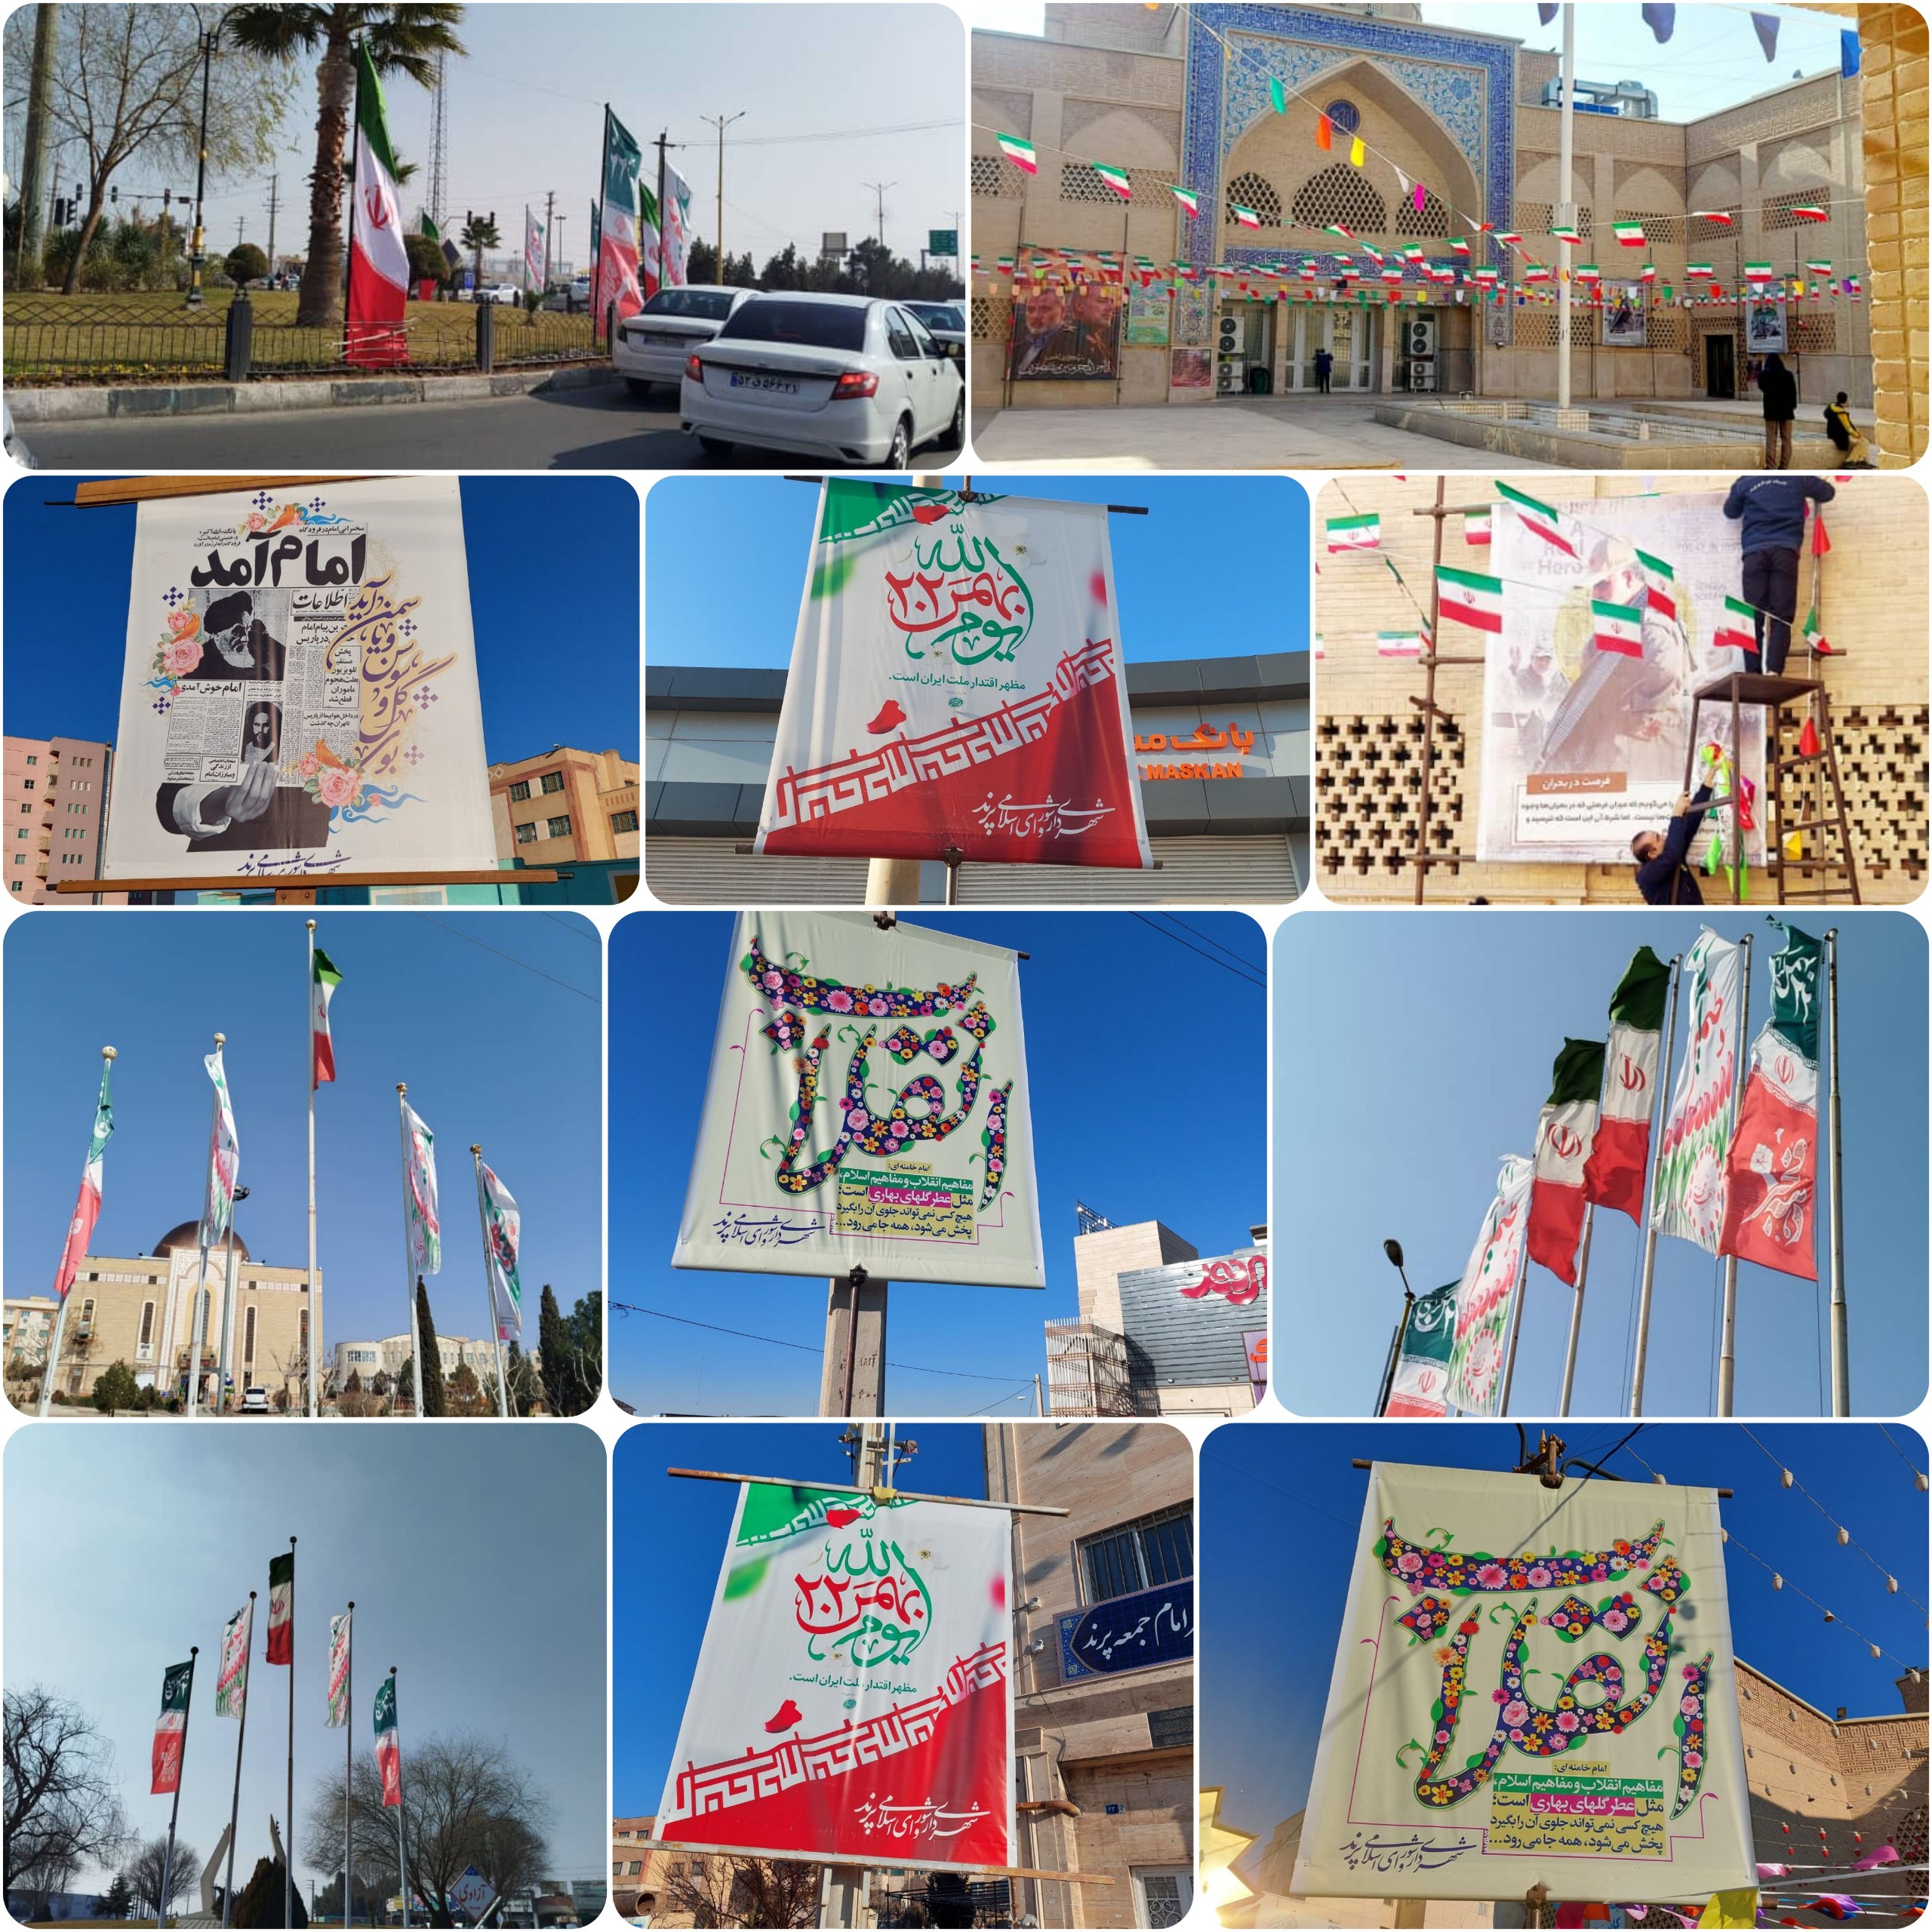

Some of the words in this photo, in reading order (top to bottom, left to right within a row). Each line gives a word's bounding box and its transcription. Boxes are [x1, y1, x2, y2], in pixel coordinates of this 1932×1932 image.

[191, 530, 281, 587] آمد
[271, 534, 366, 586] امام
[293, 589, 347, 610] اطلاعات
[302, 623, 315, 634] امام
[315, 623, 328, 634] پیام
[180, 682, 200, 692] آمدی
[921, 673, 944, 687] ایران
[947, 675, 969, 686] ملت
[970, 677, 998, 688] اقتدار
[998, 680, 1026, 691] مظهر
[199, 683, 222, 694] خوش
[222, 681, 242, 697] امام
[338, 696, 352, 705] قطع
[1171, 722, 1254, 755] بانک
[1147, 762, 1244, 780] MASKAN
[1543, 780, 1568, 789] بحران
[1583, 778, 1611, 789] فرصت
[972, 792, 996, 835] پرند
[743, 935, 1014, 1212] انقلاب
[871, 1172, 903, 1186] مفاهیم
[904, 1177, 909, 1186] و
[910, 1176, 940, 1188] انقلاب
[942, 1177, 973, 1191] مفاهیم
[869, 1188, 899, 1202] بهاری
[900, 1190, 931, 1204] گلهای
[931, 1192, 951, 1207] عطر
[952, 1195, 973, 1208] مثل
[836, 1201, 857, 1214] بگیرد
[864, 1202, 876, 1214] آن
[875, 1206, 899, 1217] جلوی
[936, 1211, 955, 1222] کسی
[955, 1212, 973, 1223] هیچ
[712, 1211, 731, 1243] پرند
[891, 1223, 909, 1231] همه
[947, 1224, 971, 1239] پخش
[1114, 1617, 1150, 1646] جمعه
[1155, 1603, 1187, 1646] امام
[1082, 1623, 1112, 1660] پرند
[1378, 1516, 1713, 1820] انقلاب
[819, 1675, 842, 1688] ایران
[865, 1679, 891, 1690] اقتدار
[891, 1683, 917, 1694] مظهر
[1592, 1764, 1607, 1774] امام
[1533, 1777, 1573, 1792] مفاهیم
[1573, 1781, 1580, 1793] و
[1582, 1780, 1620, 1795] انقلاب
[1623, 1780, 1663, 1797] مفاهیم
[1531, 1794, 1568, 1812] بهاری
[1570, 1796, 1610, 1814] گلهای
[1607, 1798, 1635, 1816] عطر
[1637, 1800, 1663, 1817] مثل
[854, 1792, 876, 1835] پرند
[1491, 1814, 1516, 1828] بگیرد
[1525, 1813, 1539, 1829] آن
[1540, 1817, 1568, 1831] جلوی
[1616, 1820, 1640, 1834] کسی
[1641, 1821, 1663, 1835] هیچ
[1559, 1836, 1582, 1846] همه
[1632, 1838, 1663, 1854] پخش
[1339, 1832, 1362, 1870] پرند
[459, 1884, 487, 1903] آزادی
